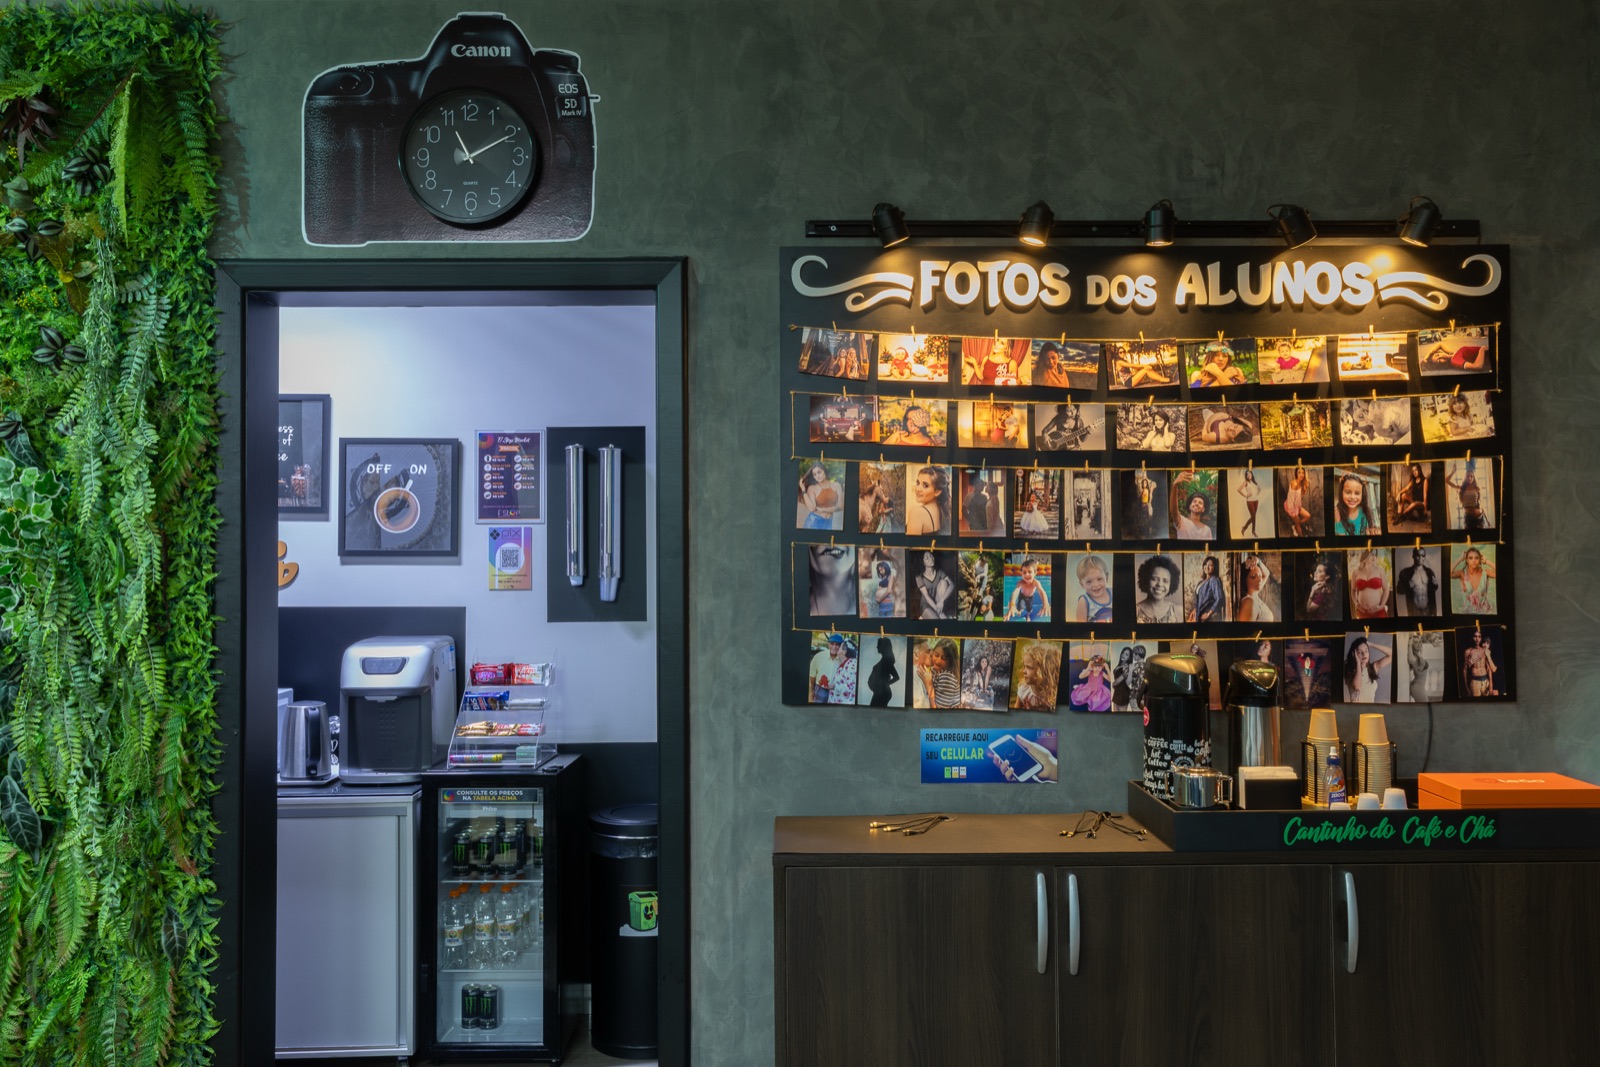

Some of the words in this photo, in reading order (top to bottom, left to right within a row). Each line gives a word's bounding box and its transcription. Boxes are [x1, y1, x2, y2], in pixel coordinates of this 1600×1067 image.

[450, 44, 511, 58] Canon
[558, 83, 578, 94] EOS
[564, 98, 577, 109] 5D
[442, 110, 454, 126] 11
[460, 104, 479, 122] 12
[488, 110, 494, 126] 1
[423, 126, 441, 144] 10
[504, 126, 517, 143] 2
[417, 148, 430, 168] 9
[513, 147, 524, 165] 3
[425, 171, 437, 190] 8
[505, 170, 516, 187] 4
[443, 189, 453, 206] 7
[465, 192, 478, 212] 6
[489, 187, 501, 205] 5
[920, 260, 1072, 307] FOTOS
[1086, 274, 1157, 306] DOS
[1174, 261, 1376, 307] ALUNOS
[366, 464, 392, 475] OFF
[410, 463, 428, 475] ON
[502, 528, 521, 540] pix
[925, 733, 970, 742] RECARREGUE
[972, 733, 989, 742] AQUI
[1148, 740, 1168, 749] COFFEE
[926, 752, 938, 760] SEU
[940, 748, 984, 760] CELULAR
[1284, 816, 1368, 846] Cantinho
[1369, 817, 1395, 839] do
[1402, 816, 1442, 846] Café
[1444, 825, 1456, 838] e
[1460, 815, 1496, 843] Chá
